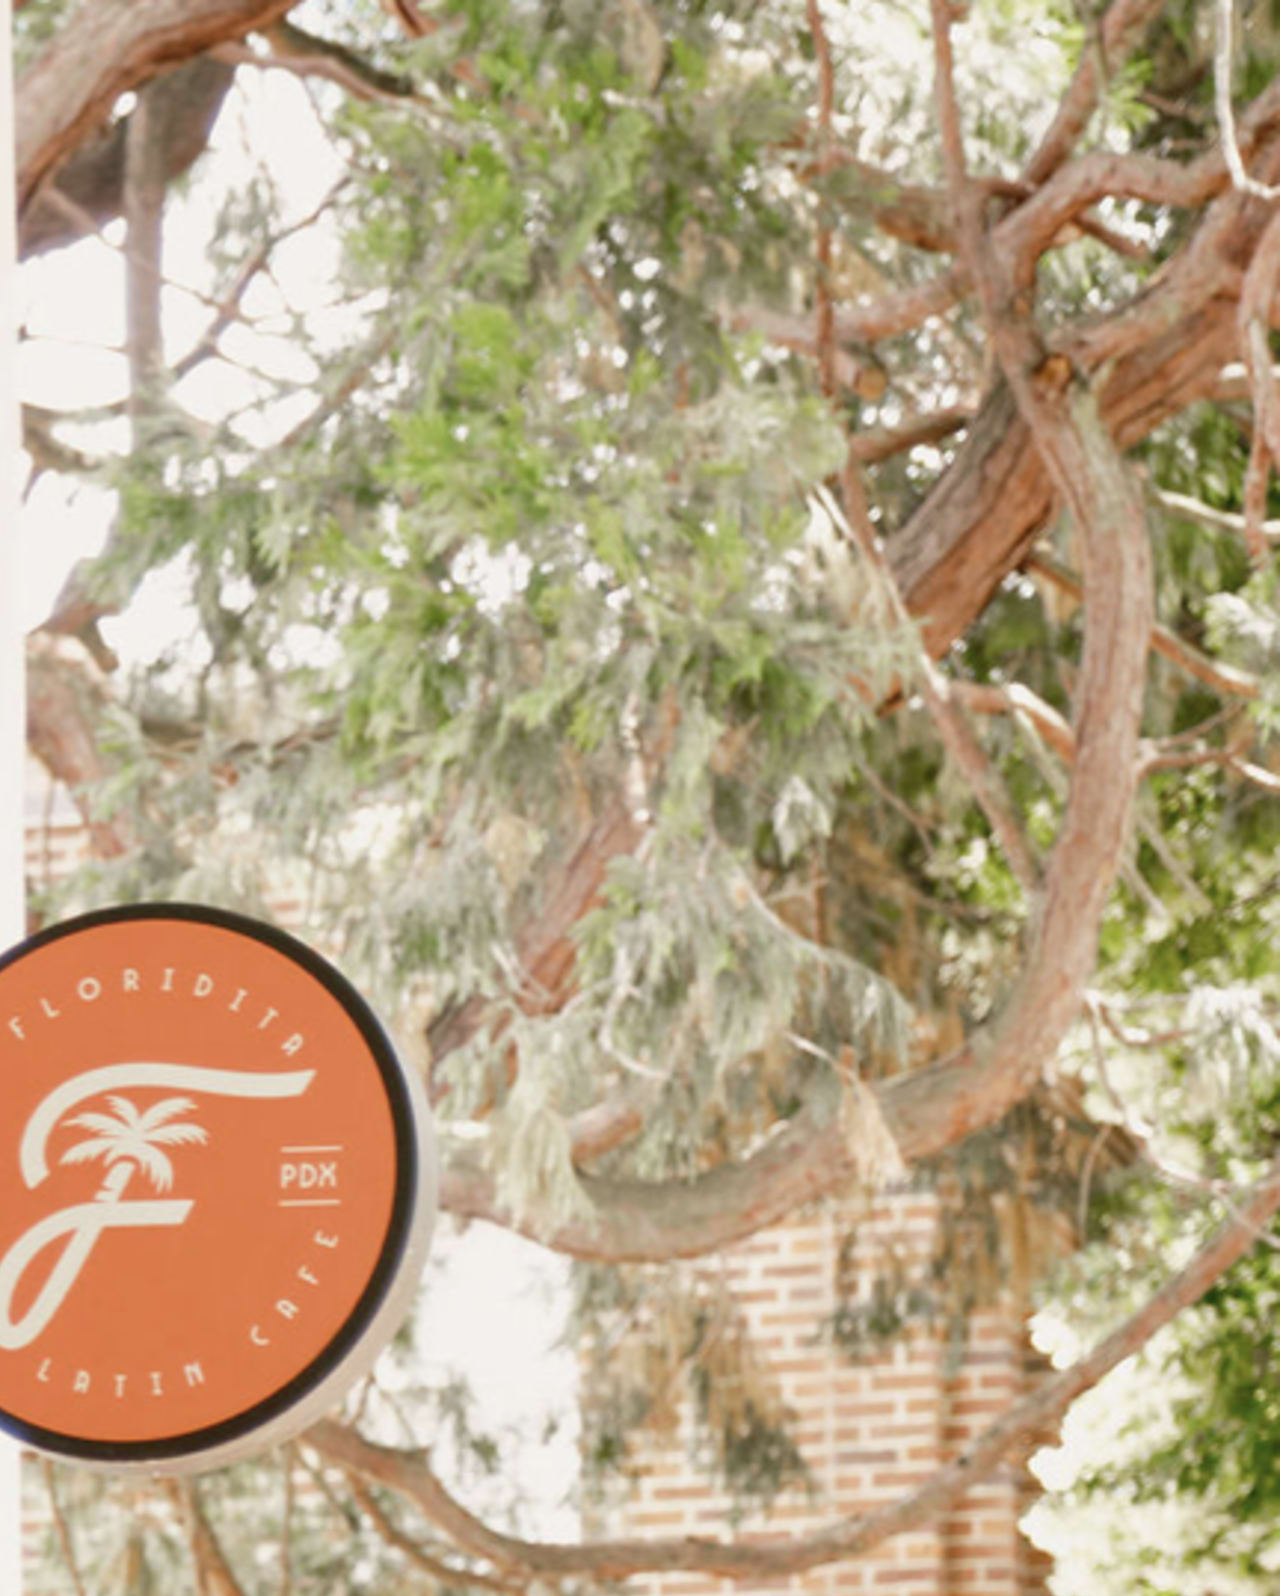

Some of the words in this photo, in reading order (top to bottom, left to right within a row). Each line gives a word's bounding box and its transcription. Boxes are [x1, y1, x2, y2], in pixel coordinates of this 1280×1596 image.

[8, 967, 305, 1056] FLORIDITA
[279, 1161, 338, 1189] PDX
[36, 1358, 205, 1398] LATIN
[250, 1229, 340, 1347] CAFE
